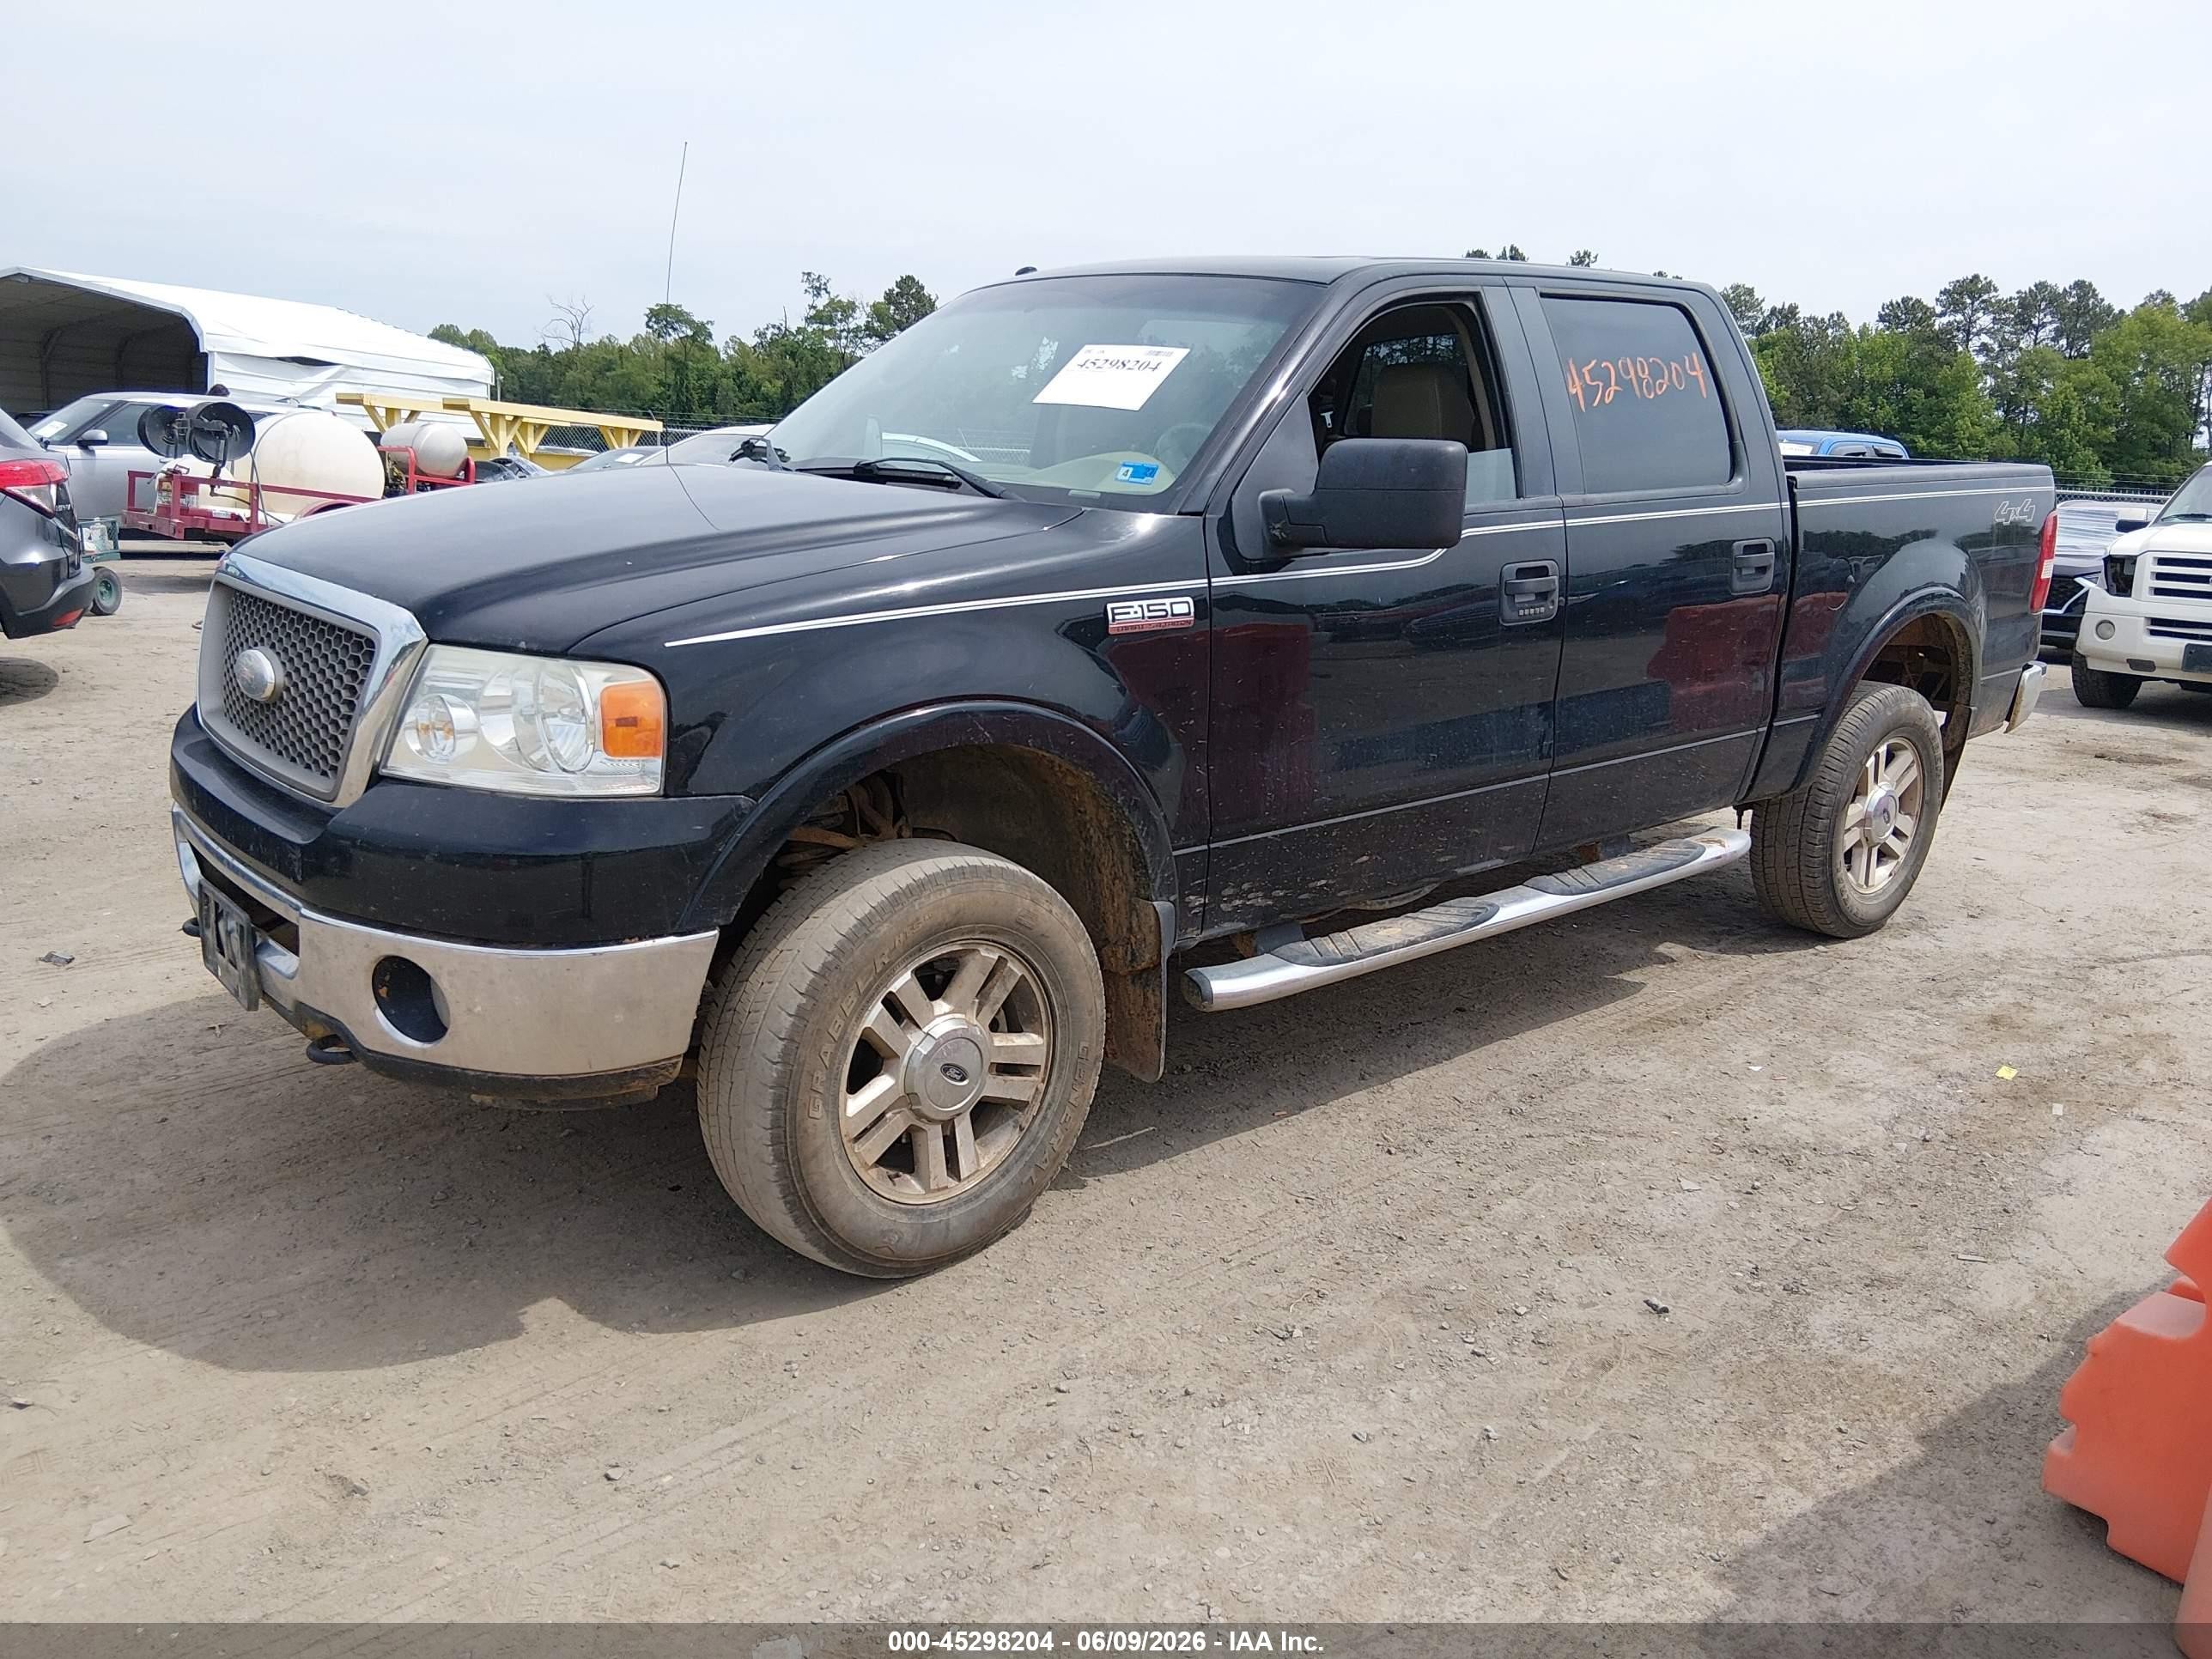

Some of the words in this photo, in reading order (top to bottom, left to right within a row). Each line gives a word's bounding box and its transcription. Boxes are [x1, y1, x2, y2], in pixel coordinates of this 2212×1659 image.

[1076, 357, 1163, 373] 45298204
[1566, 352, 1707, 413] 45298204
[1994, 498, 2036, 526] 4x4
[1110, 601, 1192, 623] F-150
